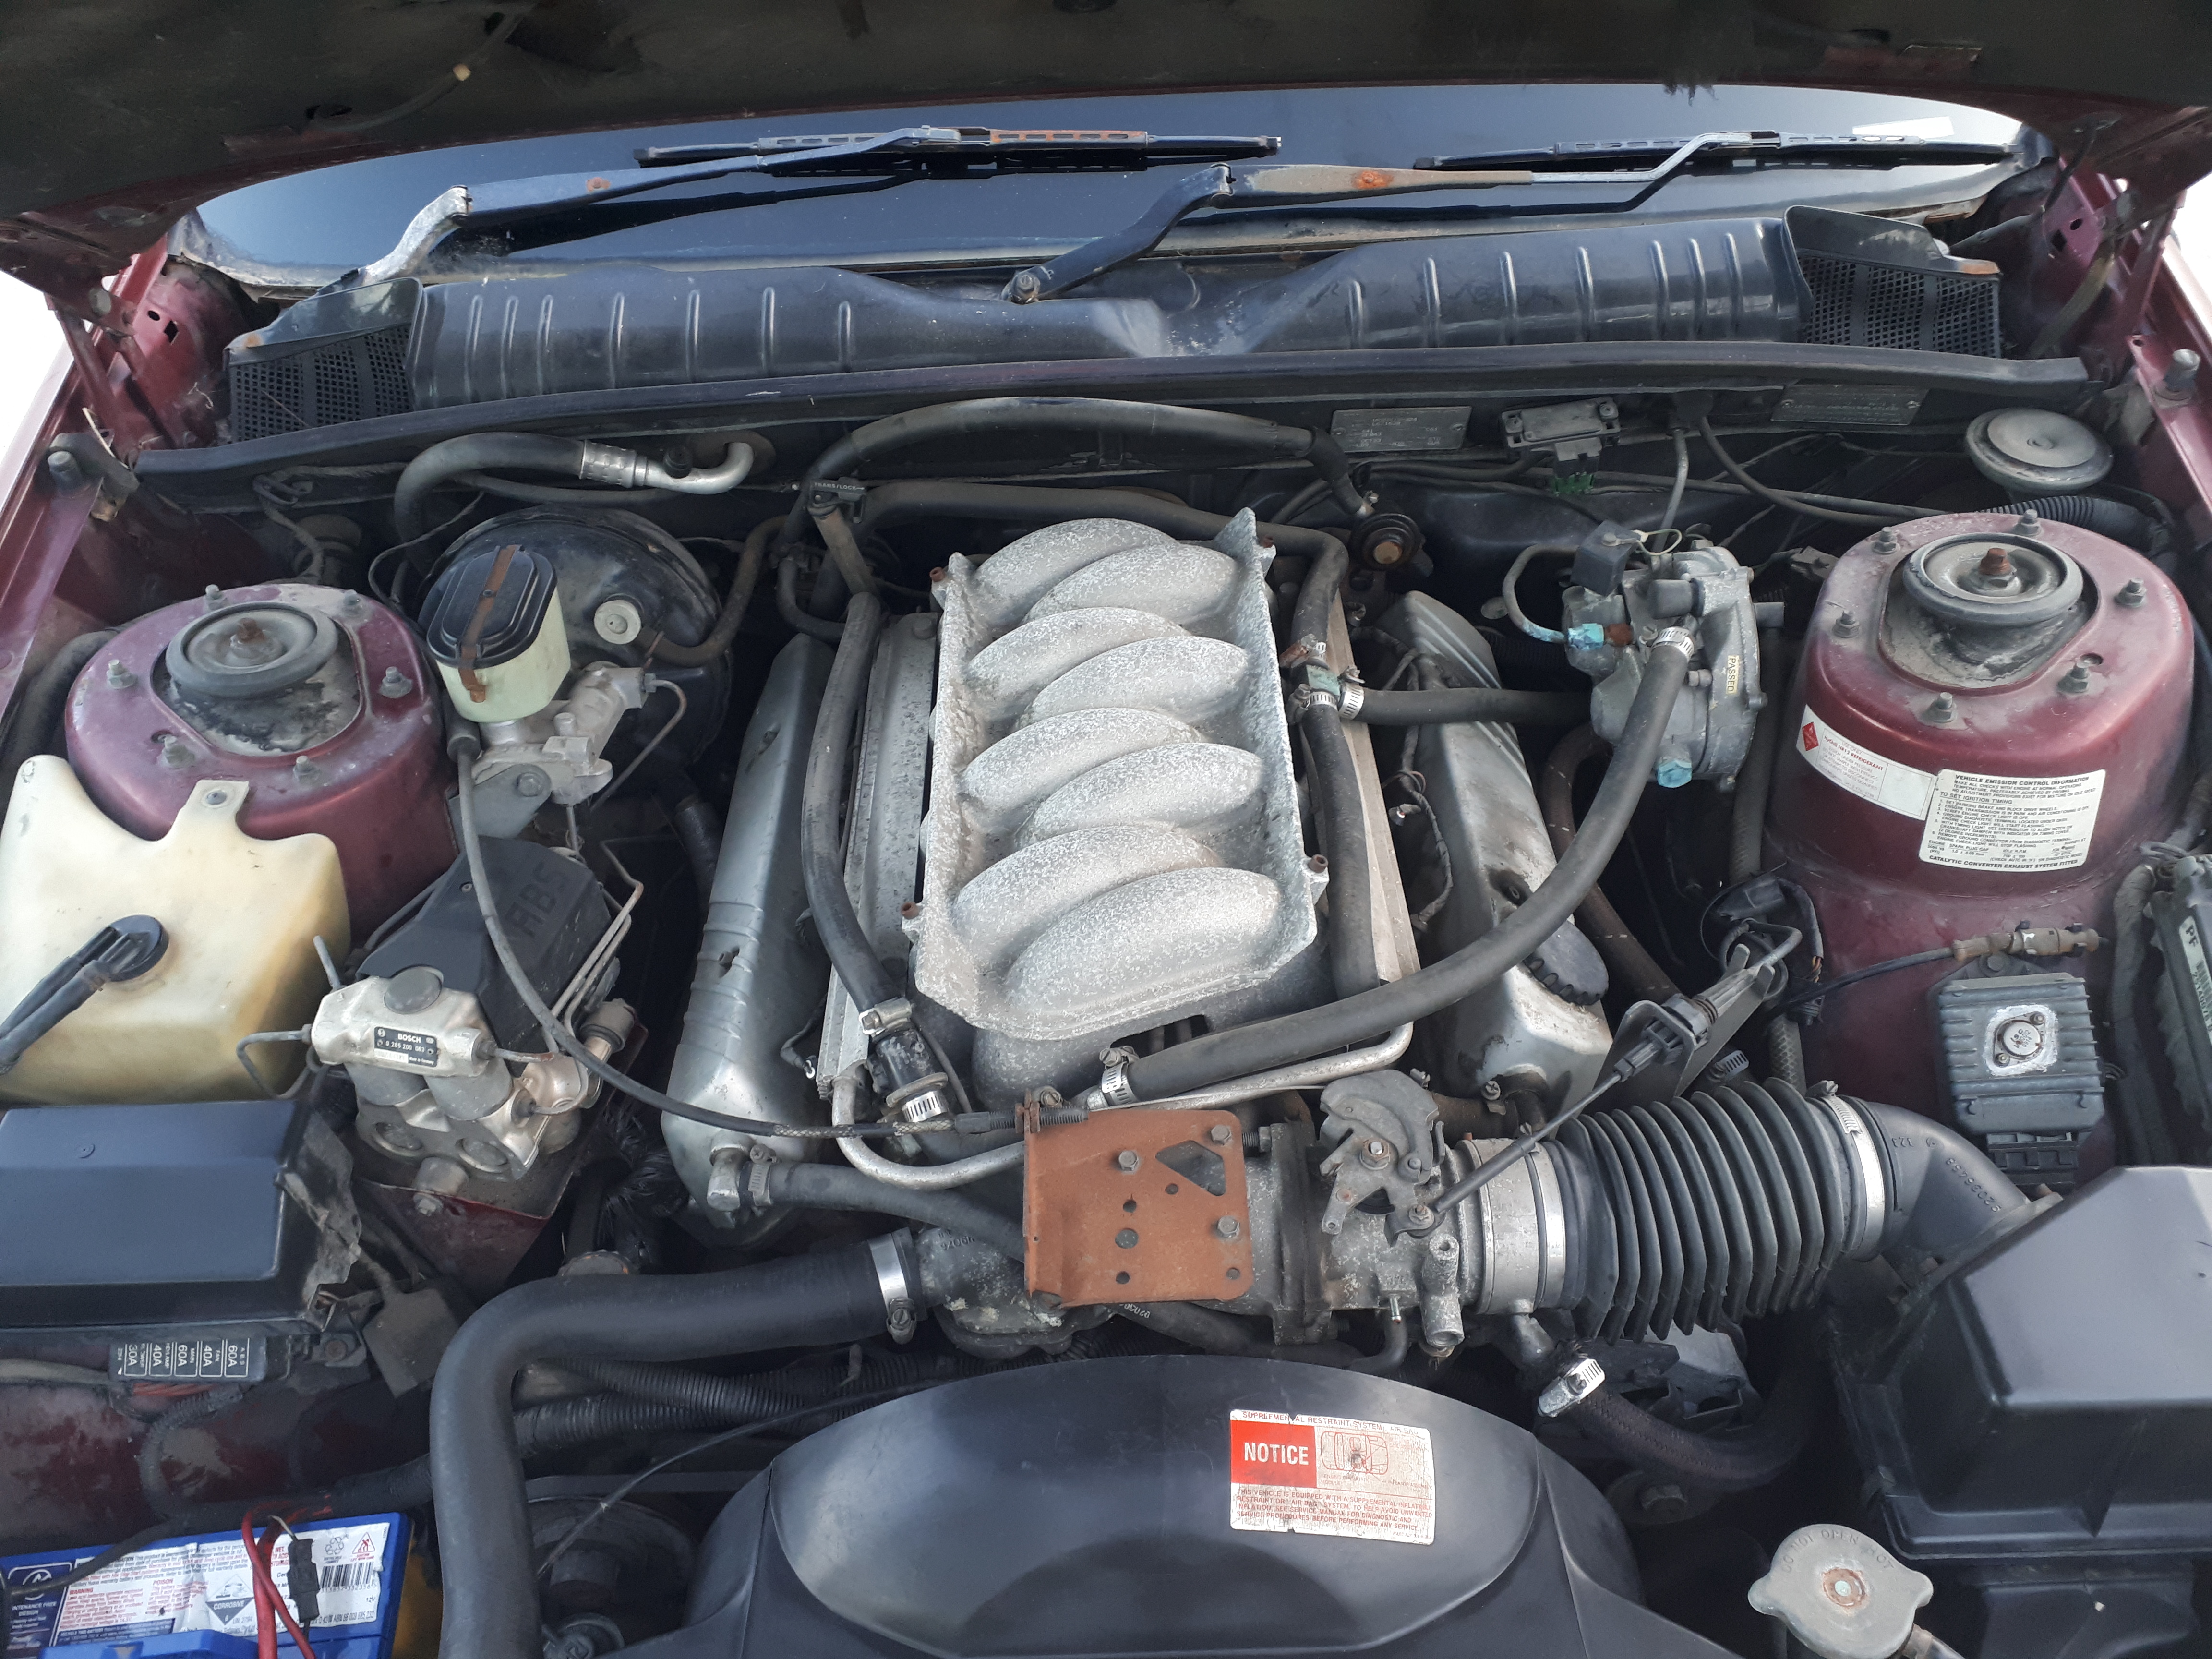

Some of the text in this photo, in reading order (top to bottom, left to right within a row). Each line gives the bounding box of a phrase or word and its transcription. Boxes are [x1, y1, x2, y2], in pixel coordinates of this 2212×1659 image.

[1728, 658, 1736, 692] PASSED
[1851, 753, 1883, 771] REFRIGERANT
[2051, 776, 2089, 785] INFORMATION
[1929, 855, 1962, 864] CATALYTIC
[505, 860, 567, 938] ABS
[2186, 924, 2198, 947] PF
[397, 1033, 421, 1044] BOSCH
[128, 1345, 138, 1366] 30A
[153, 1345, 162, 1367] 40A
[178, 1345, 188, 1367] 60A
[203, 1345, 213, 1367] 40A
[228, 1345, 238, 1367] 60A
[1243, 1411, 1304, 1422] SUPPLEMENAL
[1308, 1417, 1350, 1426] RESTRAINT
[1353, 1421, 1382, 1431] SYSTEM
[1244, 1442, 1309, 1465] NOTICE
[1291, 1491, 1323, 1500] EQUIPPED
[1350, 1497, 1396, 1507] SUPPLEMENTAL
[1339, 1517, 1378, 1527] PERFORMING
[1361, 1512, 1397, 1521] DIAGNOSTIC
[1401, 1509, 1432, 1518] UNWANTED
[1781, 1529, 1895, 1573] DO NOT OPEN HOT
[214, 1600, 245, 1610] CORROSIVE
